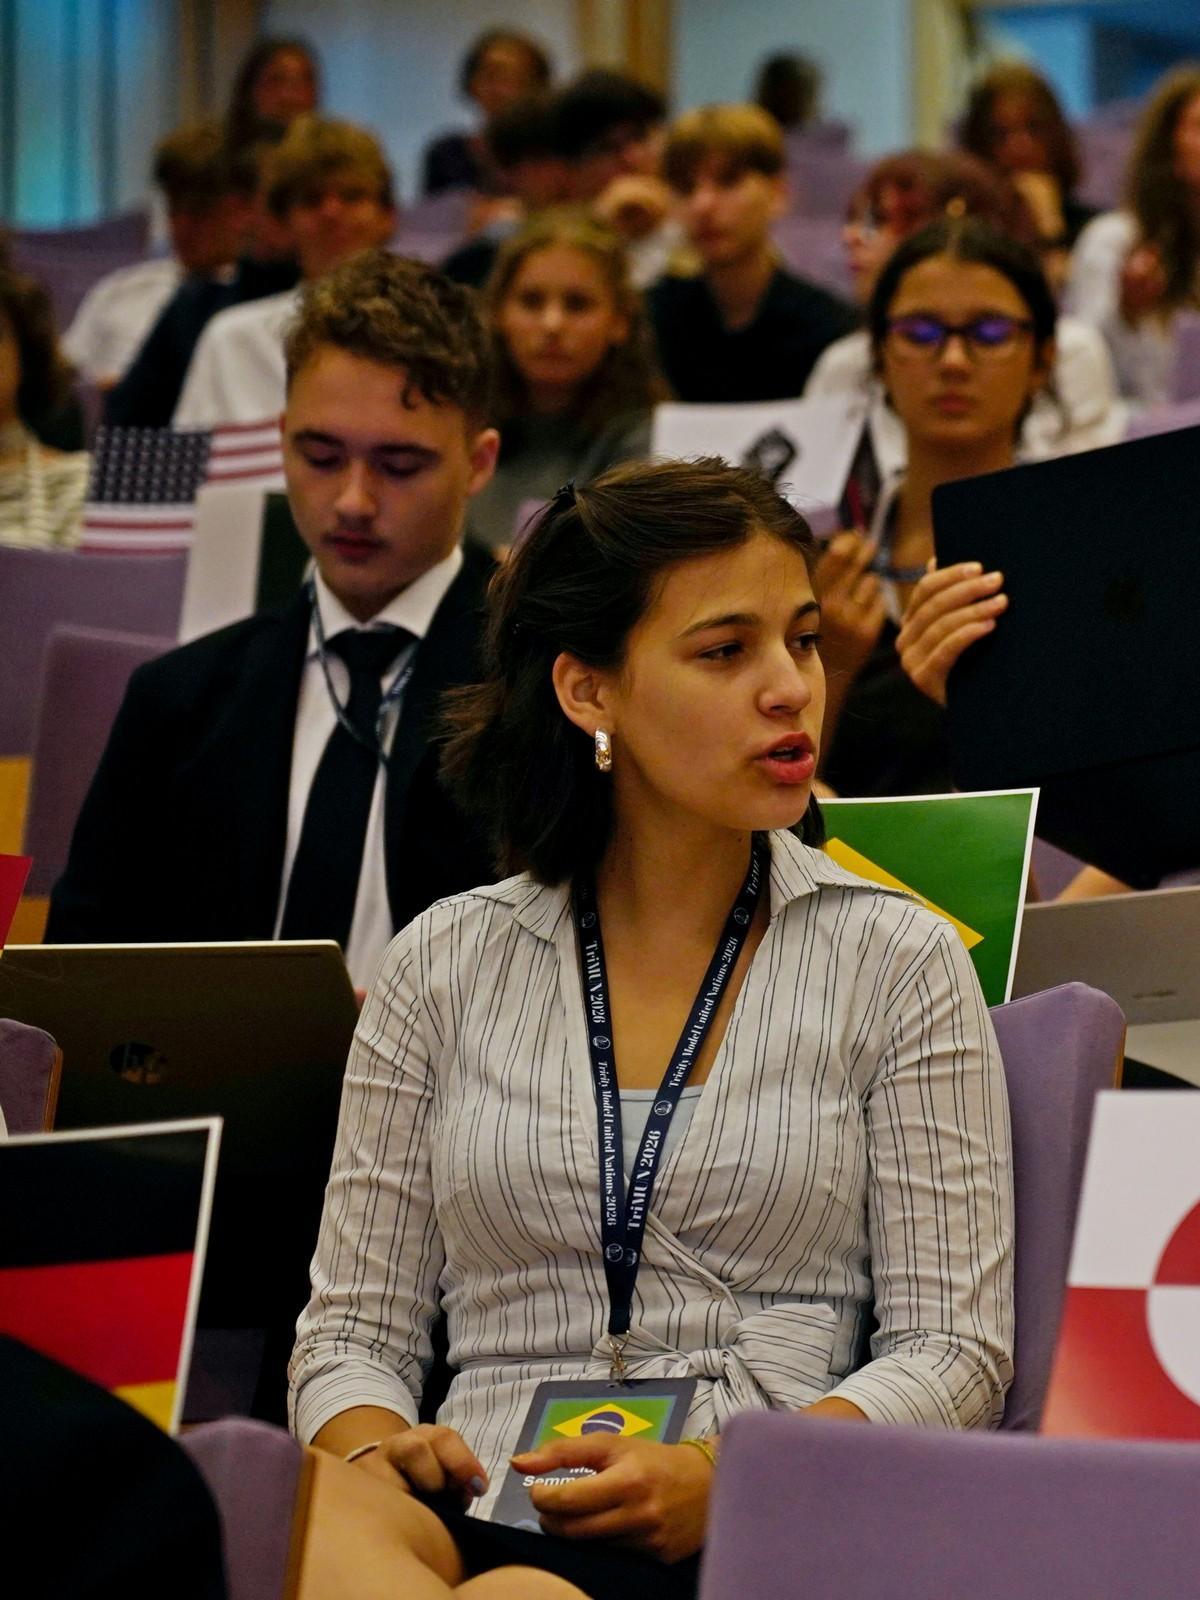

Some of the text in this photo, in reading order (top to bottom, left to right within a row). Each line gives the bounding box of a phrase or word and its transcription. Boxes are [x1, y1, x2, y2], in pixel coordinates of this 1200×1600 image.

[585, 940, 606, 1024] TriMUN 2026
[668, 936, 739, 1088] Tricity Model United Nations 2026
[598, 1061, 617, 1226] Tricity Model United Nations 2026
[626, 1130, 662, 1231] TriMUN 2026
